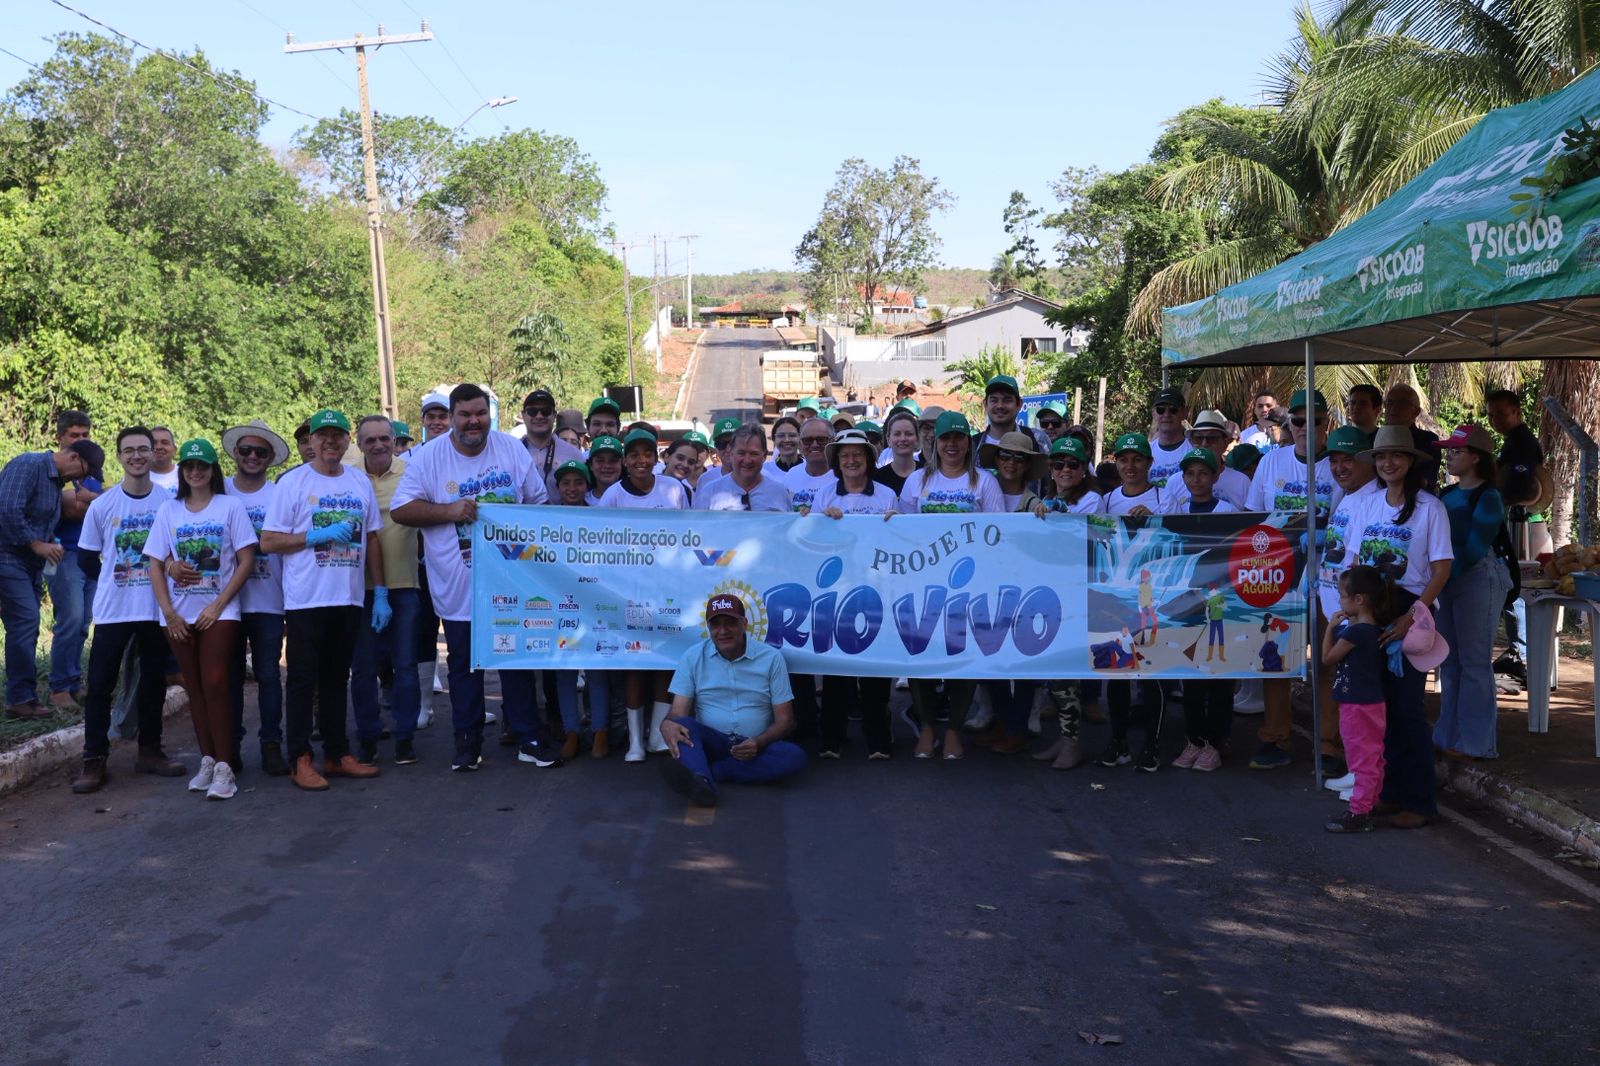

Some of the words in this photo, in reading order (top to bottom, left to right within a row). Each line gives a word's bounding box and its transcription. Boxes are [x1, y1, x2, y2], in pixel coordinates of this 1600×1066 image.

[1486, 214, 1563, 260] SICOOB
[1370, 244, 1425, 286] SICOOB
[1505, 256, 1560, 280] Integração
[1286, 276, 1324, 306] SICOOB
[483, 525, 535, 542] Unidos
[540, 526, 573, 543] Pela
[578, 527, 677, 550] Revitalização
[682, 529, 701, 547] do
[870, 521, 1000, 575] PROJETO
[534, 547, 557, 563] Rio
[567, 547, 654, 566] Diamantino
[1241, 558, 1273, 567] ELIMINE
[1273, 558, 1280, 566] A
[1237, 565, 1285, 585] PÓLIO
[1242, 582, 1280, 594] AGORA
